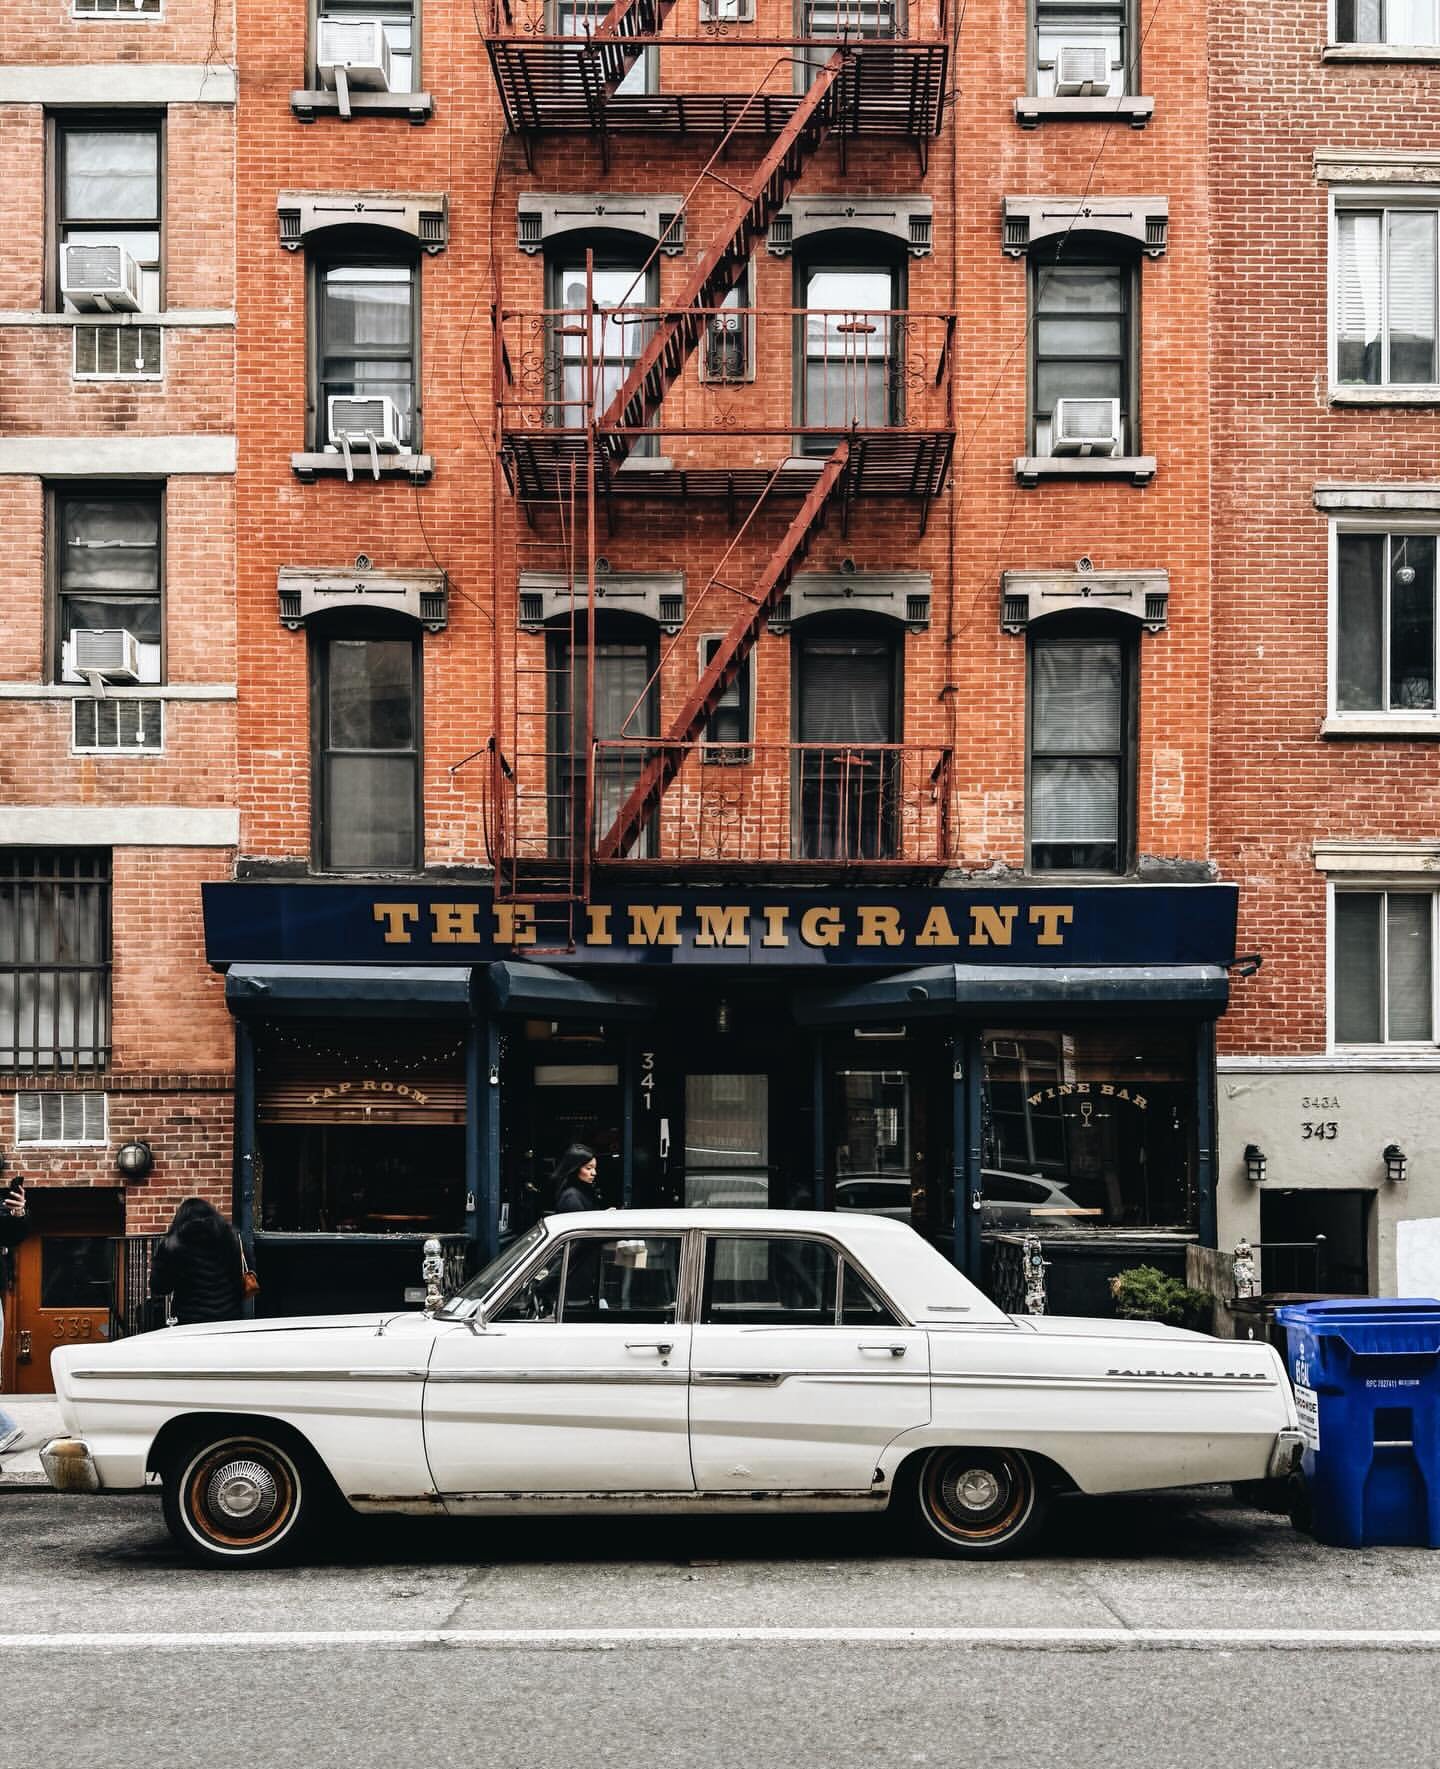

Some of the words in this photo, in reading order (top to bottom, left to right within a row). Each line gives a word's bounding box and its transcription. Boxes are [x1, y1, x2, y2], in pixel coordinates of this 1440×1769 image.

[374, 903, 537, 944] THE
[586, 904, 1074, 946] IMMIGRANT
[306, 1081, 352, 1105] TAP
[362, 1080, 428, 1105] ROOM
[641, 1052, 655, 1110] 341
[1027, 1083, 1090, 1106] WINE
[1100, 1084, 1147, 1109] BAR
[1301, 1096, 1341, 1109] 343A
[1300, 1122, 1339, 1140] 343
[53, 1316, 91, 1337] 339
